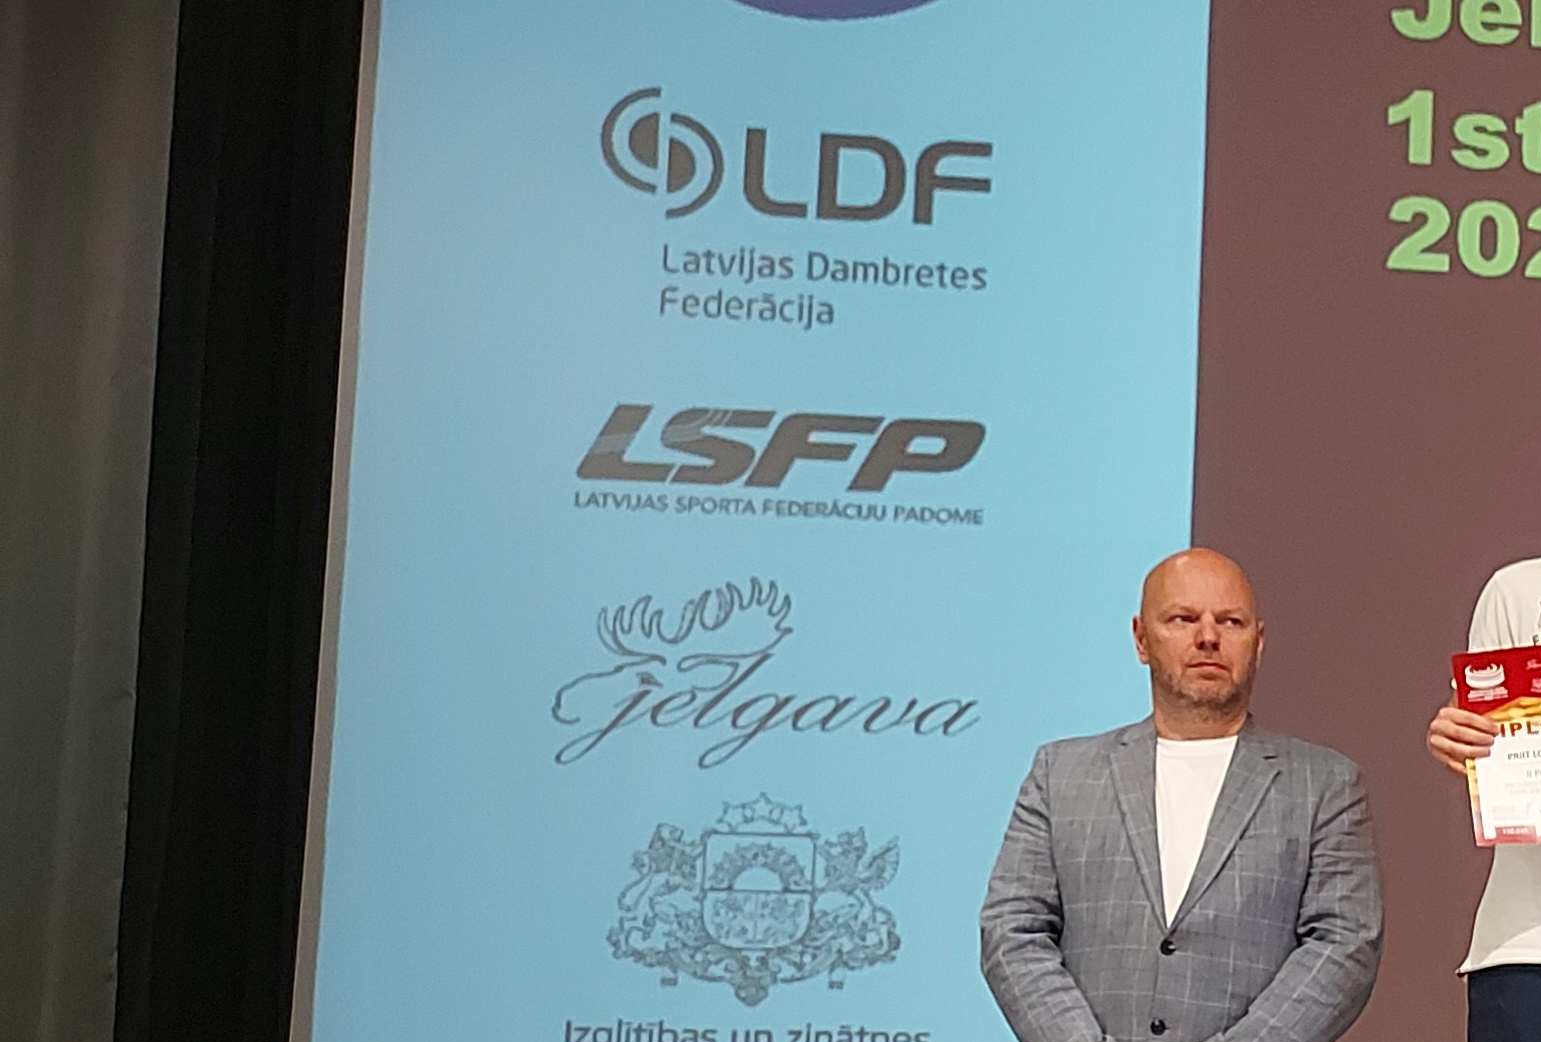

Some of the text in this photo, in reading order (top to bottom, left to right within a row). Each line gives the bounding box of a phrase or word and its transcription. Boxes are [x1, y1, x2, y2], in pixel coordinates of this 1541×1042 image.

[743, 128, 993, 225] LDF
[662, 244, 988, 291] Latvijas Dambretes
[659, 286, 834, 331] Federācija
[576, 402, 987, 492] LSFP
[573, 491, 984, 525] LATVIJAS SPORTA FEDERĀCIJU PADOME
